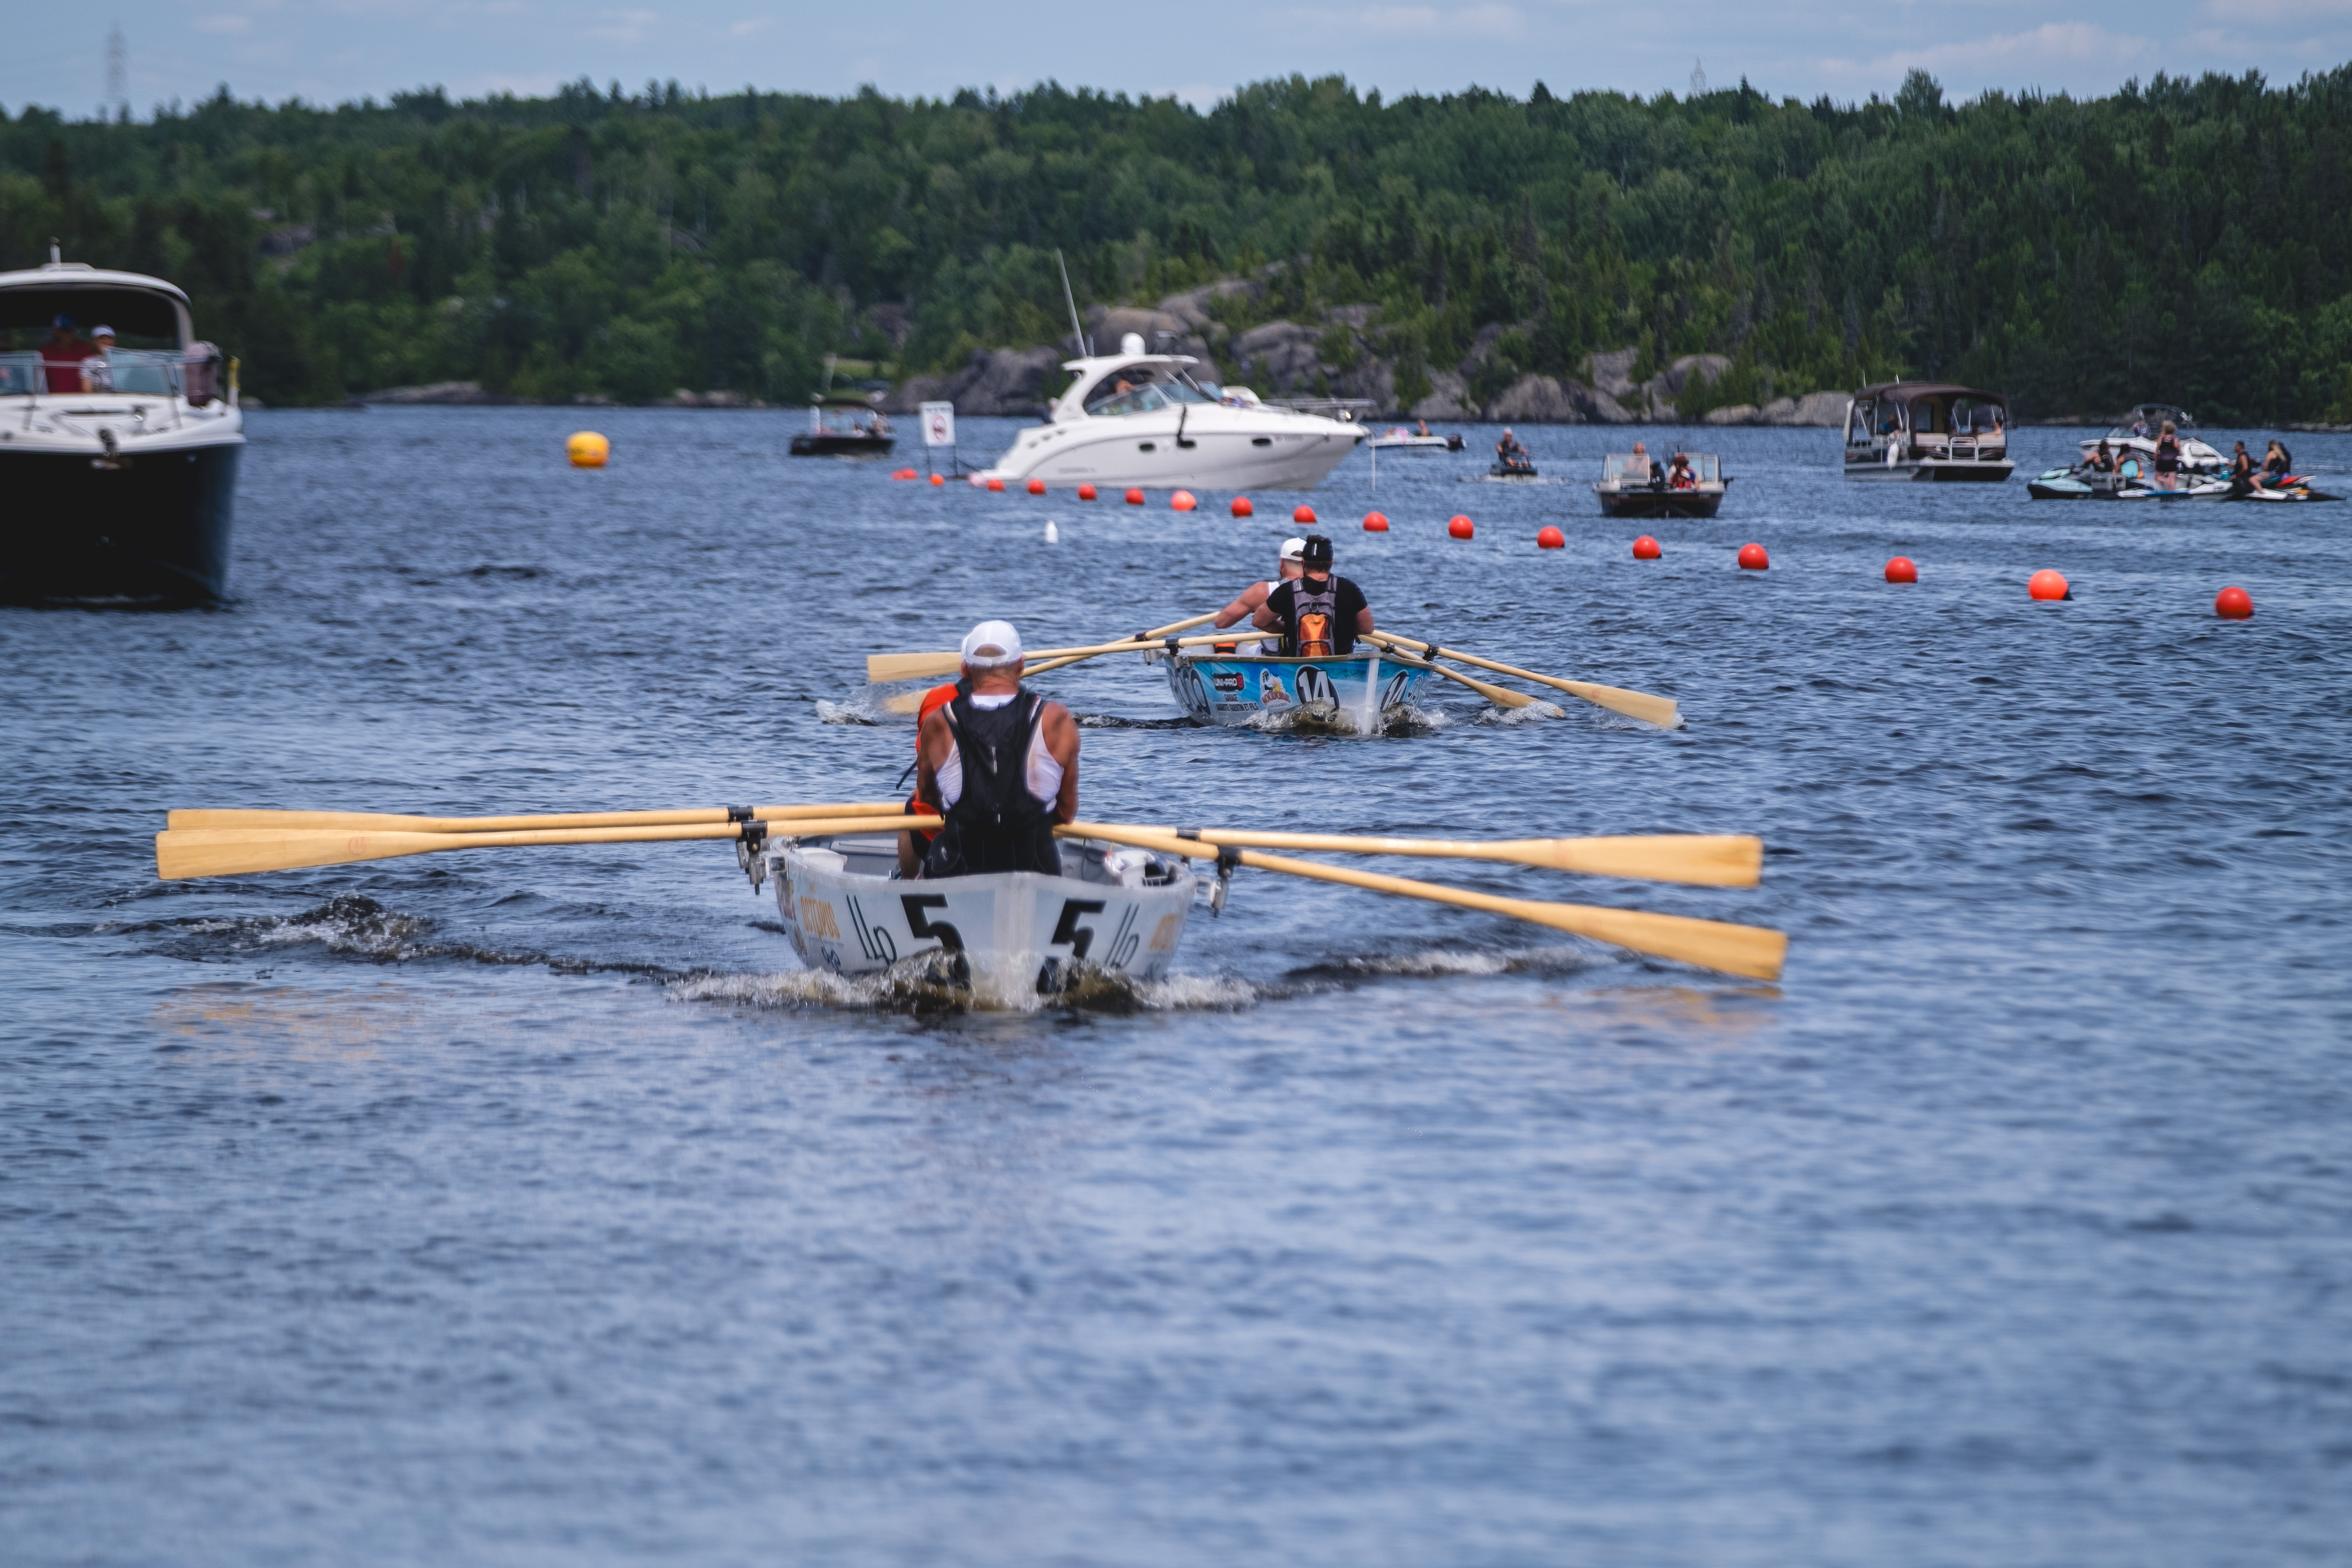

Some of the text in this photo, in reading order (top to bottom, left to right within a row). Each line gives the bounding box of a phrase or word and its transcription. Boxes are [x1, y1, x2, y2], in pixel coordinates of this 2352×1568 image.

[1214, 678, 1237, 686] UNI-PRO
[1298, 671, 1336, 707] 14
[1382, 676, 1410, 711] 14
[1249, 702, 1258, 711] FILS
[899, 893, 972, 992] 5
